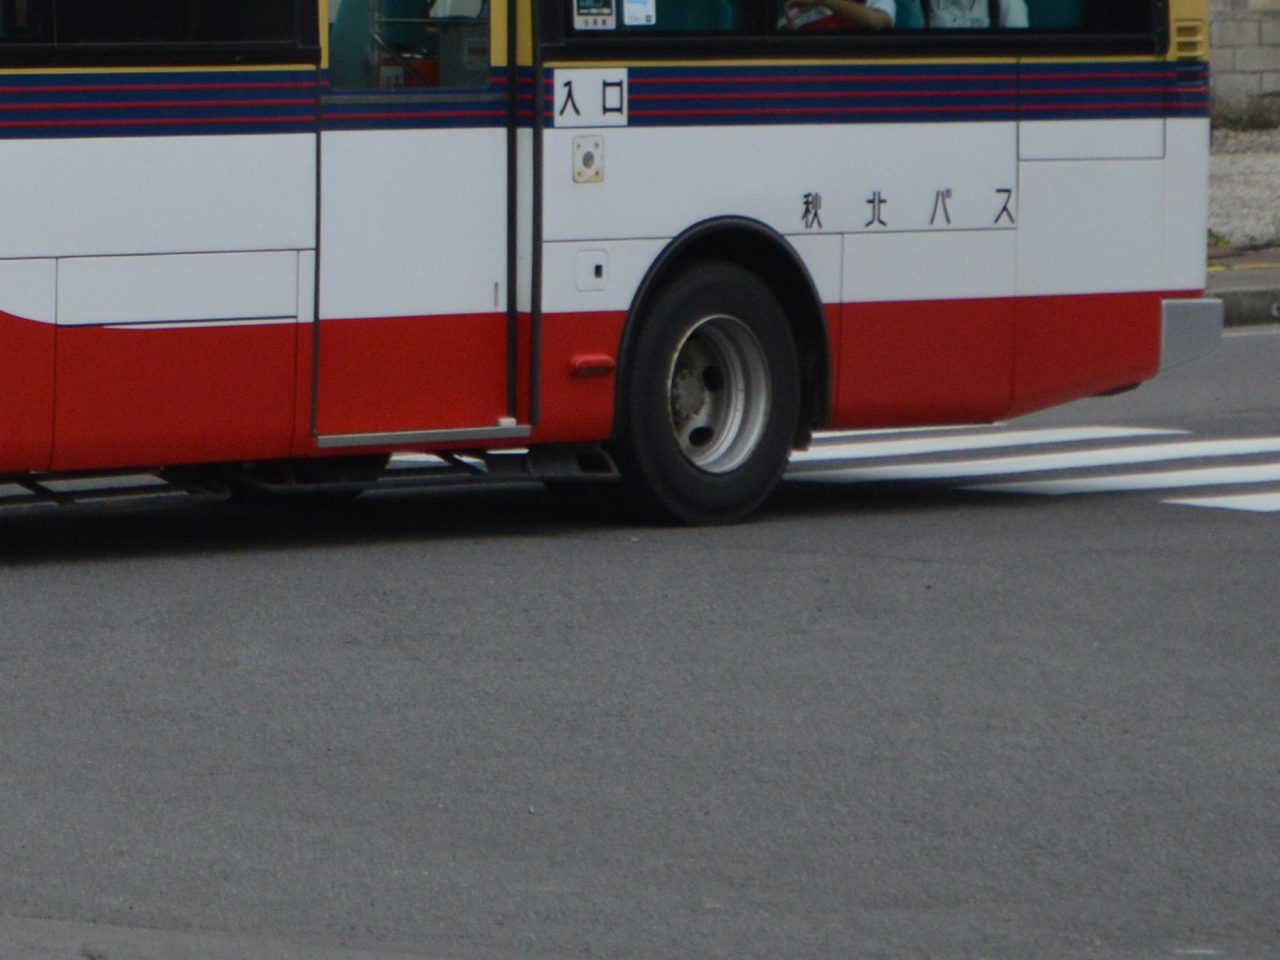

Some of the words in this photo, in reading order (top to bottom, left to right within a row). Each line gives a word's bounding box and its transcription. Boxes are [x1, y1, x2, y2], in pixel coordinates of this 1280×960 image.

[559, 80, 624, 116] 入口
[801, 188, 1015, 229] 秋北バス
